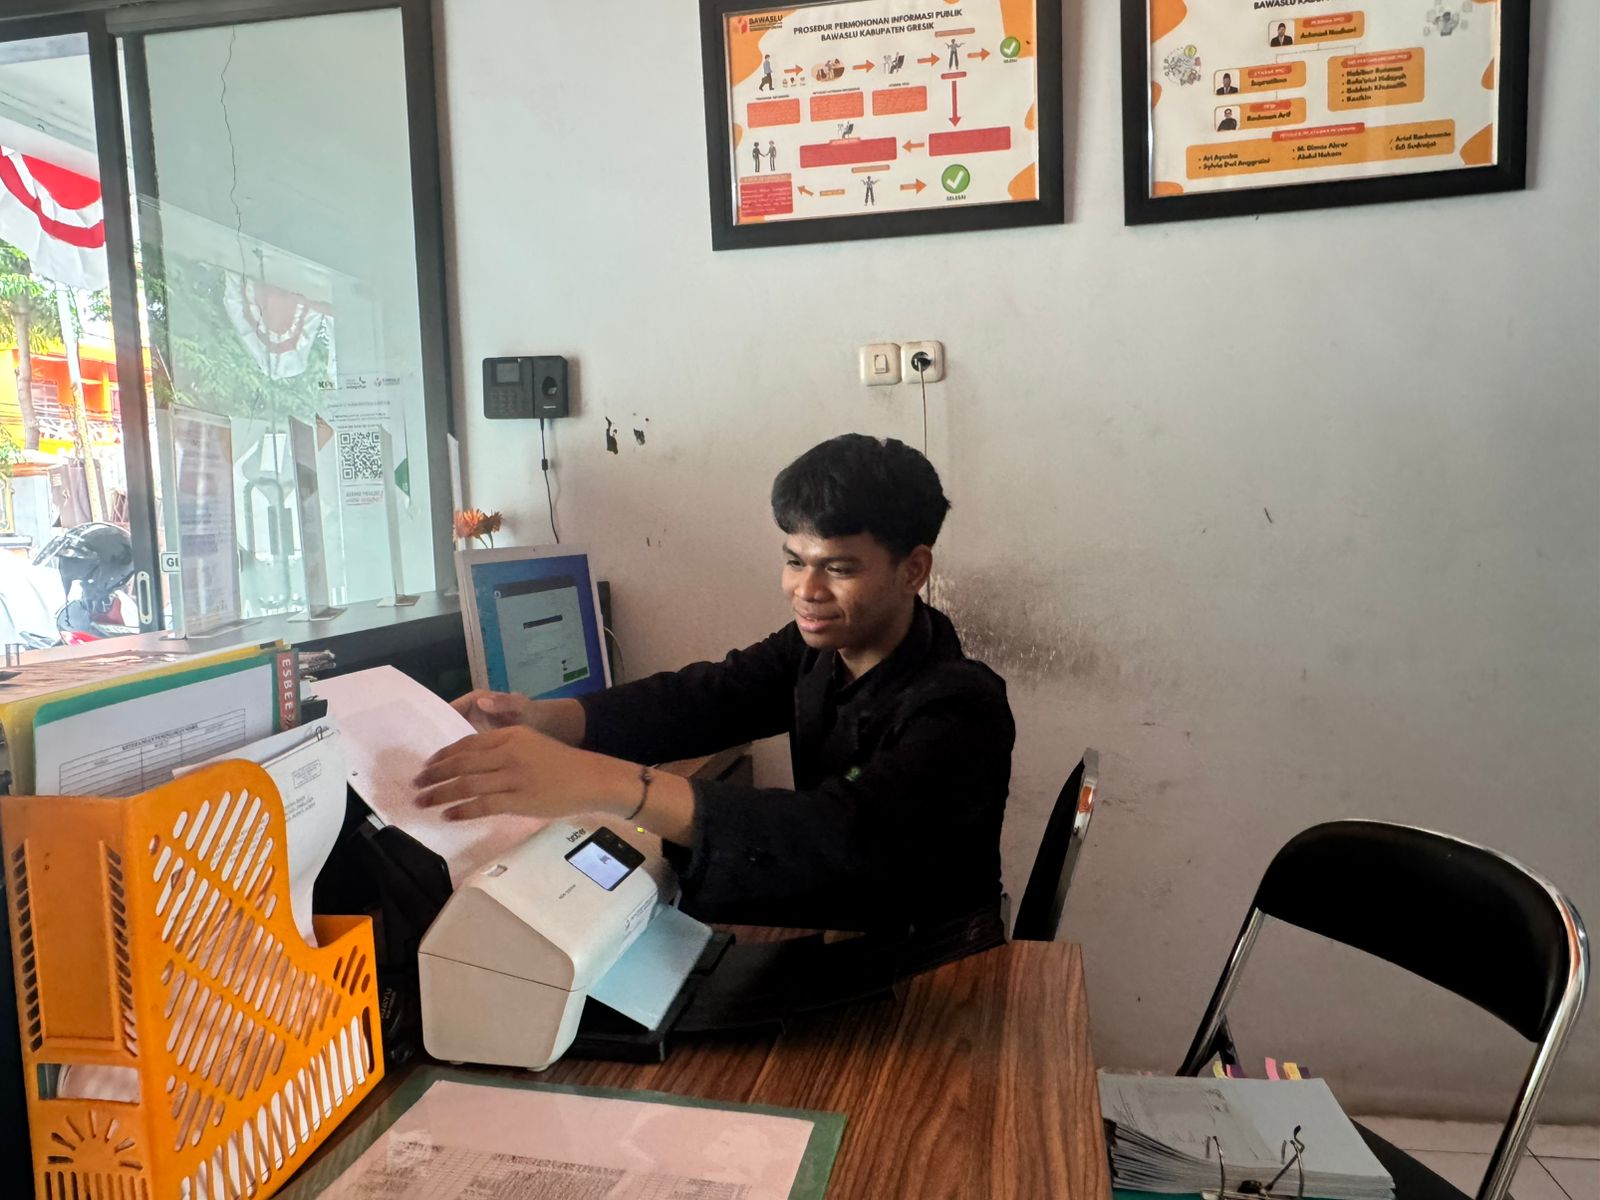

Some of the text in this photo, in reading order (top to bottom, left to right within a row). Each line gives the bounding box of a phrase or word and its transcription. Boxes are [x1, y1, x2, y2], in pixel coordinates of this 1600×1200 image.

[748, 15, 784, 25] BAWASLU
[793, 23, 833, 35] PROSEDUR
[834, 17, 890, 31] PERMOHONAN
[891, 12, 934, 24] INFORMASI
[935, 8, 963, 19] PUBLIK
[820, 22, 935, 42] BAWASLU KABUPATEN GRESIK
[282, 658, 293, 711] ESBEE
